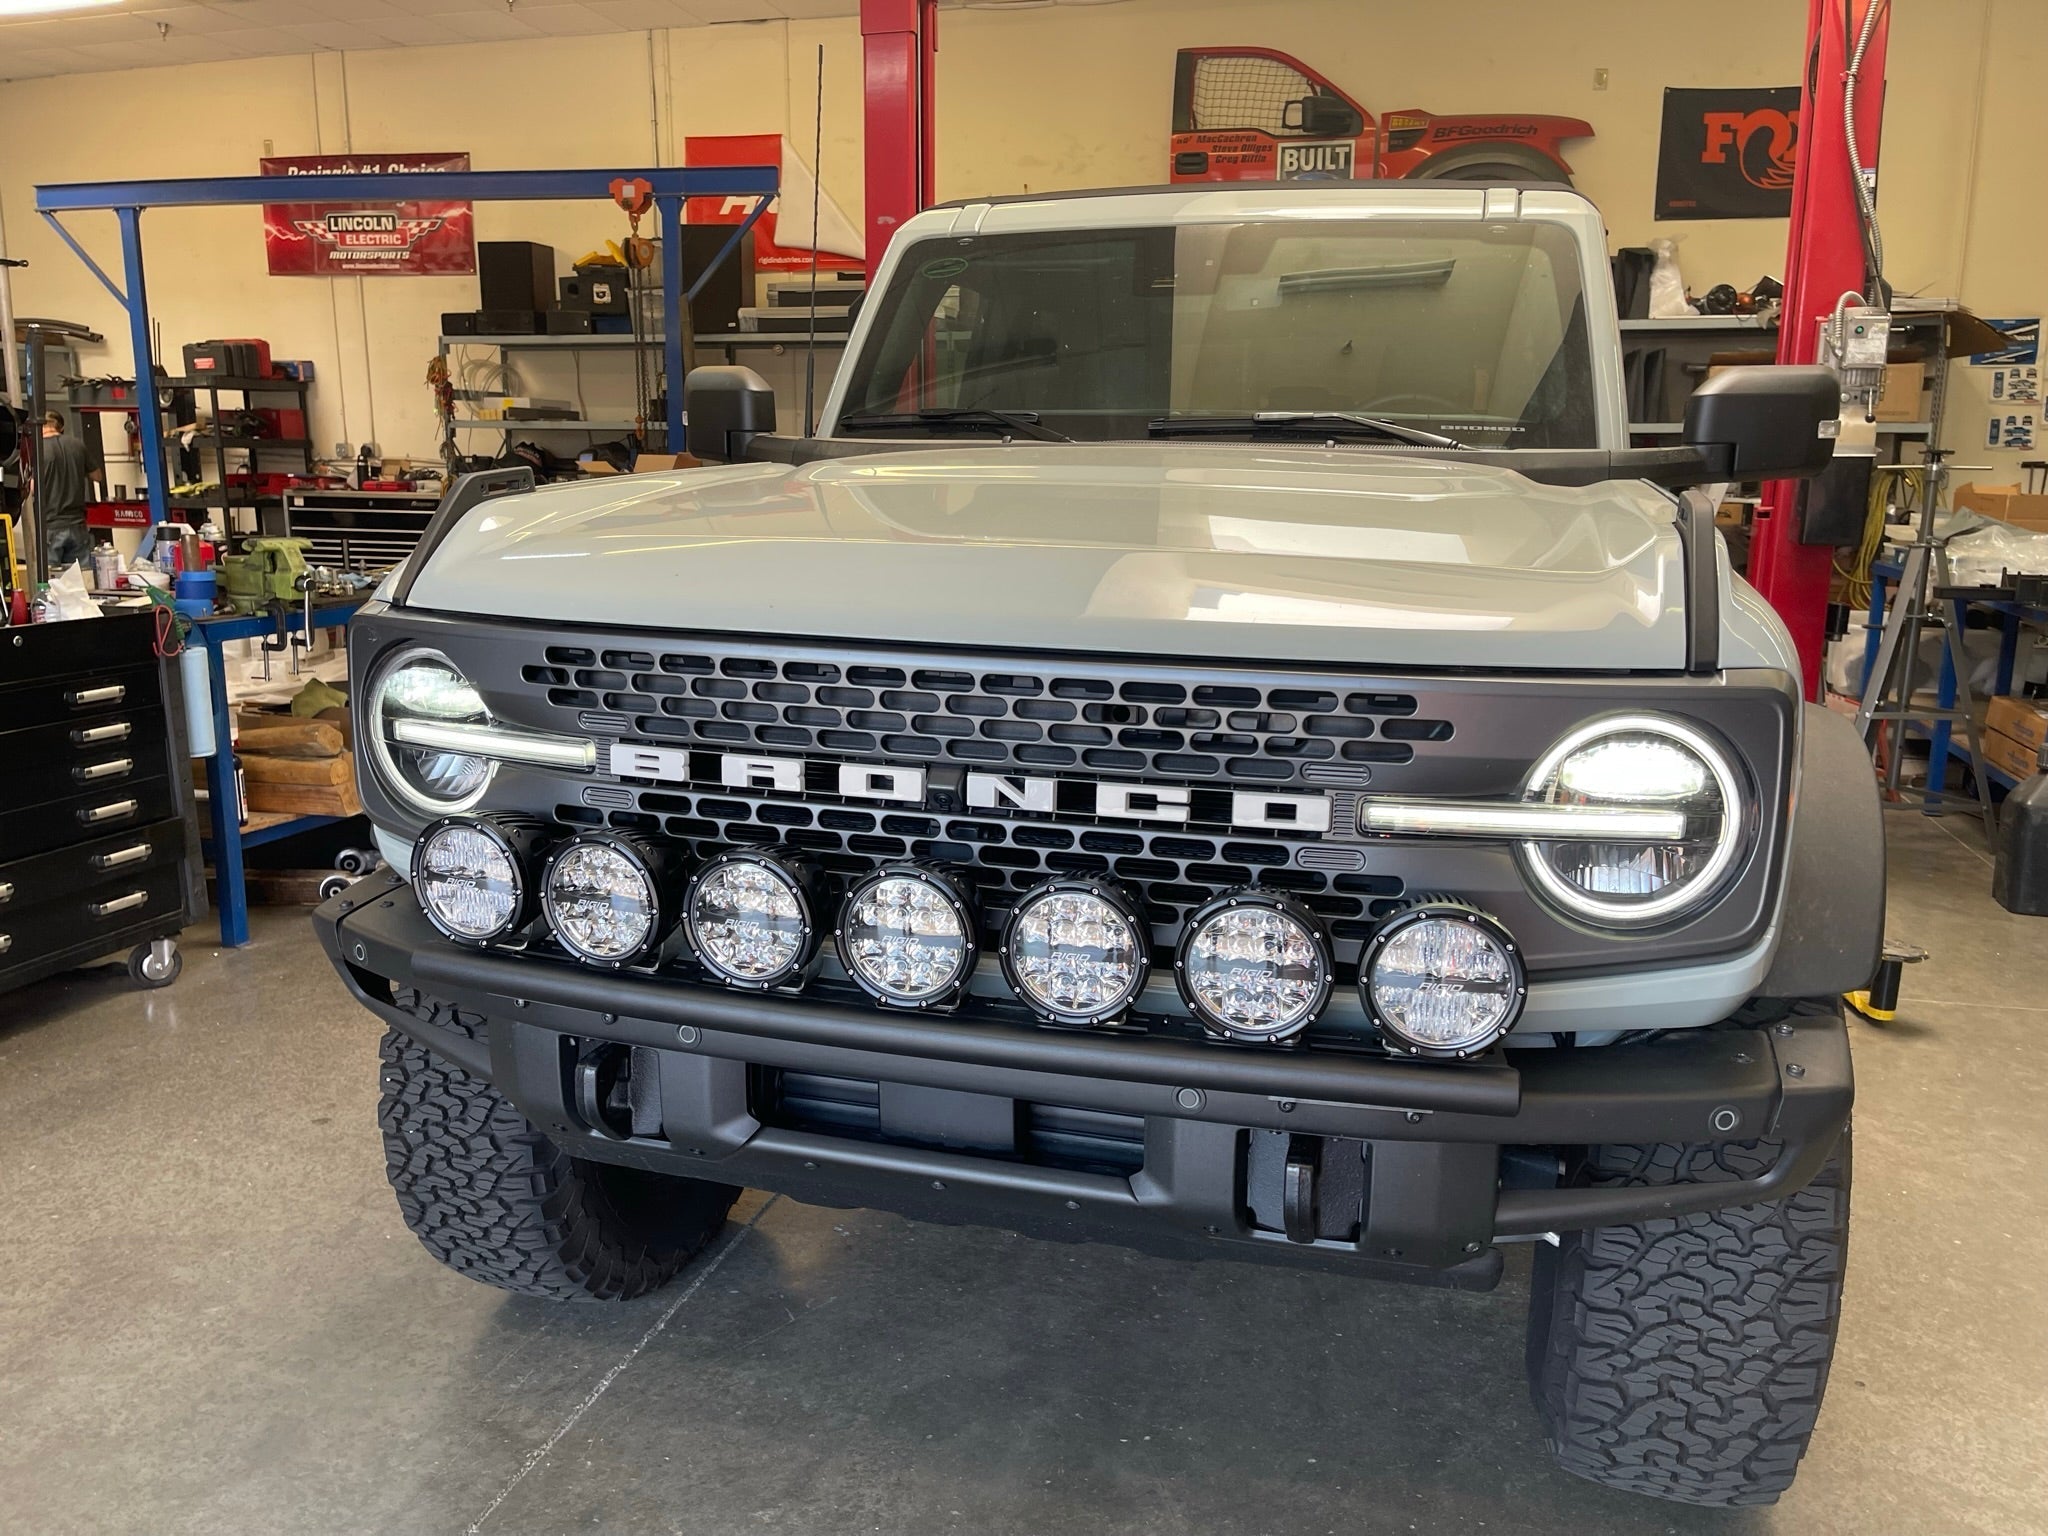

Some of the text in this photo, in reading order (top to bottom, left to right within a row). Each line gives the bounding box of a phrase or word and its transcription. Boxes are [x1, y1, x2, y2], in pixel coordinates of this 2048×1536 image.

[1433, 124, 1538, 139] BFGoodrich
[1211, 145, 1239, 153] Steve
[1215, 155, 1239, 164] Greg
[1284, 147, 1350, 173] BUILT
[330, 216, 394, 232] LINCOLN
[345, 234, 402, 245] ELECTRIC
[329, 250, 410, 260] MOTORSPORTS
[610, 743, 1333, 832] BRONCO
[446, 877, 477, 889] RIGID
[577, 898, 609, 909] RIGID
[725, 918, 759, 929] RIGID
[882, 935, 920, 945] RIGID
[1051, 951, 1091, 962] RIGID
[1230, 967, 1273, 978] RIGID
[1419, 982, 1464, 991] RIGID
